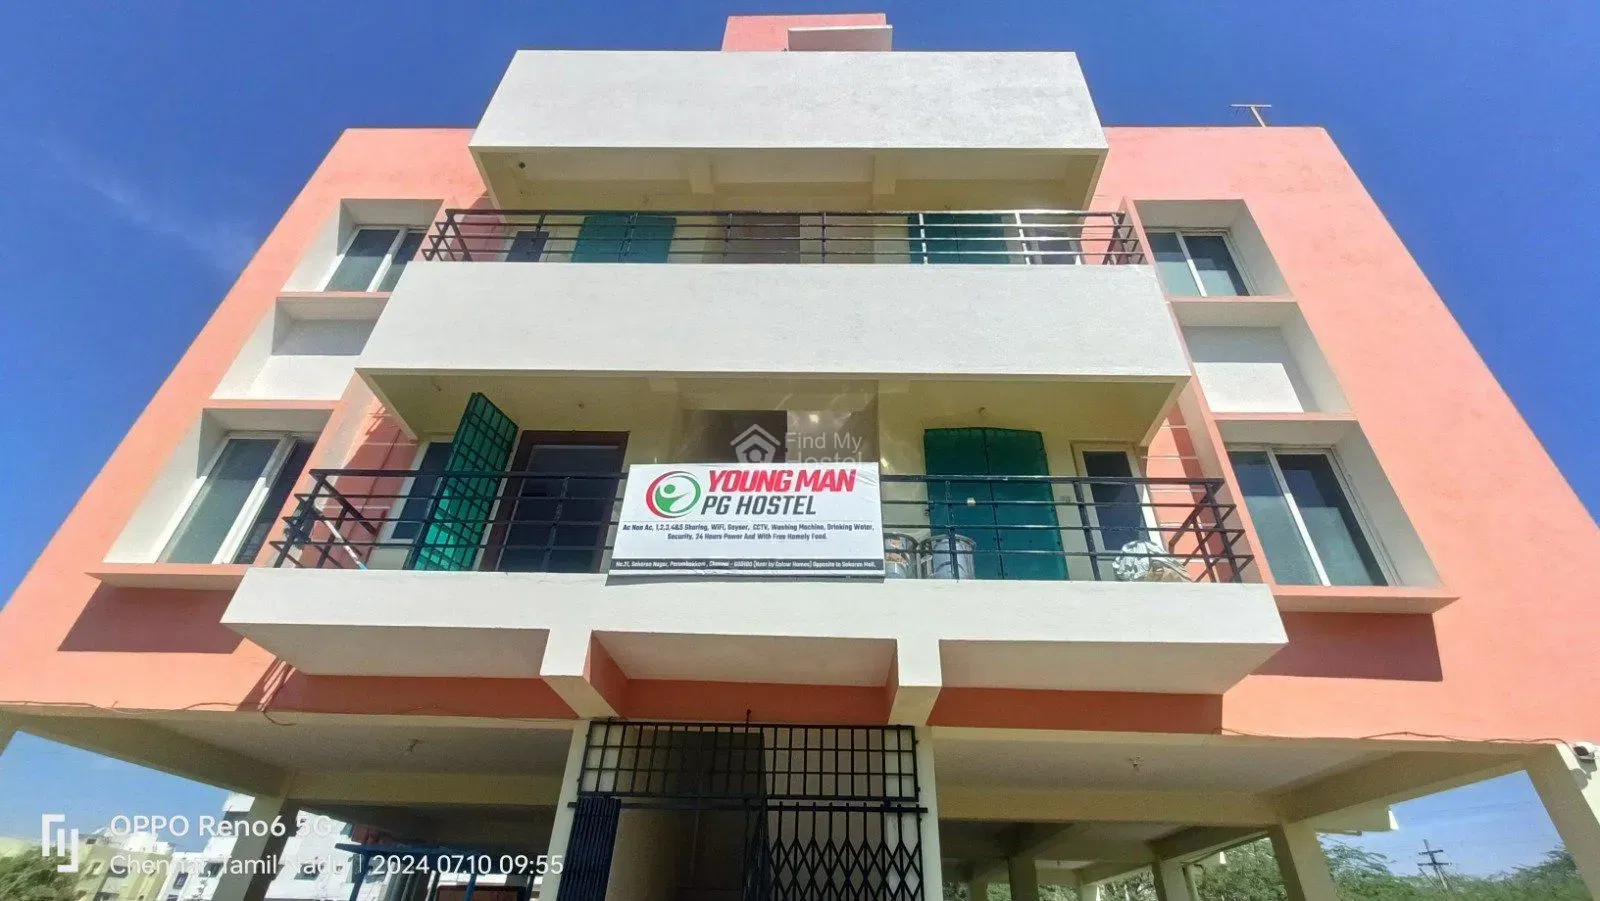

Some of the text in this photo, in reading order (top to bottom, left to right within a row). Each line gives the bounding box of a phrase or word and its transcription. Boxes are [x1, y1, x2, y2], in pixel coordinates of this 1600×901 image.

[708, 469, 857, 493] YOUNG MAN
[701, 495, 817, 515] PG HOSTEL
[684, 524, 709, 532] Sharing,
[771, 524, 798, 532] Washing
[826, 524, 852, 532] Drinking
[854, 524, 874, 532] Water,
